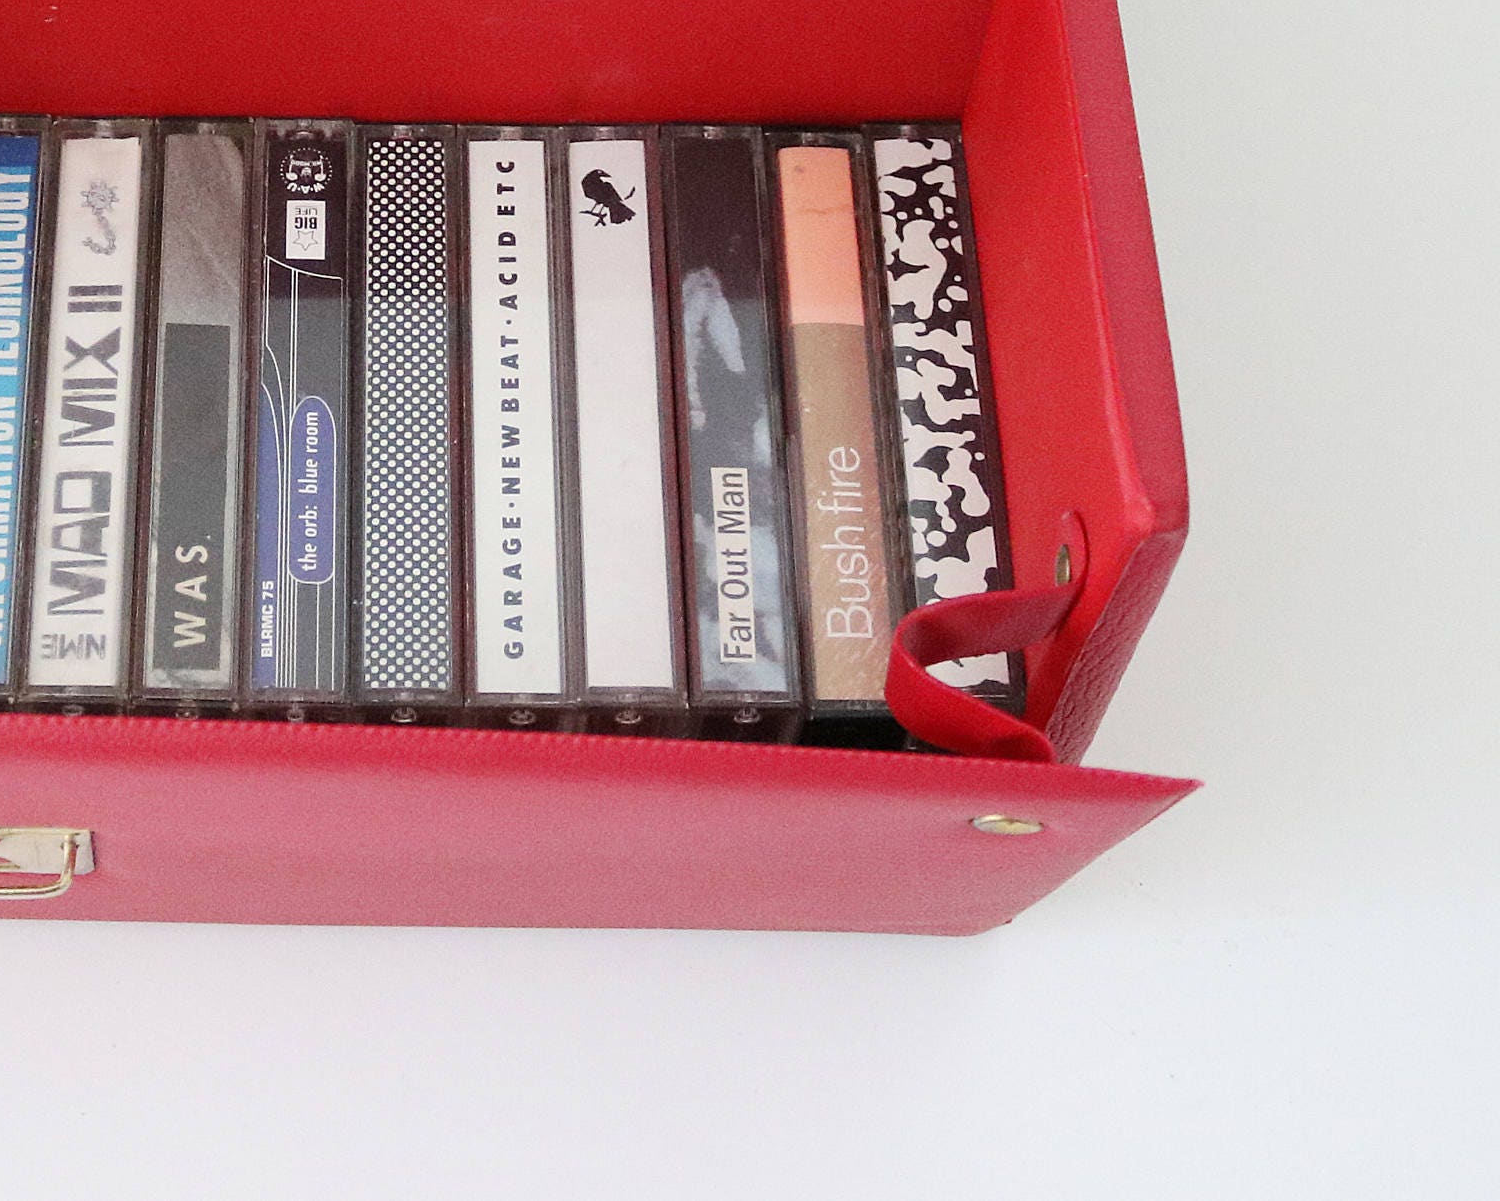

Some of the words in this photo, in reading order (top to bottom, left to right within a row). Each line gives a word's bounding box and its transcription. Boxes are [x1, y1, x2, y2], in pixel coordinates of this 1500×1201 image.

[495, 160, 516, 216] ETC
[294, 217, 318, 230] BIG
[295, 207, 318, 216] LIFE
[66, 285, 123, 313] II
[58, 327, 122, 447] MIX
[304, 411, 319, 454] room
[297, 458, 318, 495] blue
[817, 445, 863, 516] fire
[298, 505, 318, 538] orb:
[717, 472, 746, 535] Man
[47, 470, 112, 616] MAD
[297, 543, 318, 572] the
[262, 580, 275, 599] 75
[719, 548, 750, 601] Out
[821, 525, 874, 640] Bush
[41, 633, 106, 660] NME
[261, 605, 275, 658] BLRMC
[723, 612, 754, 662] Far
